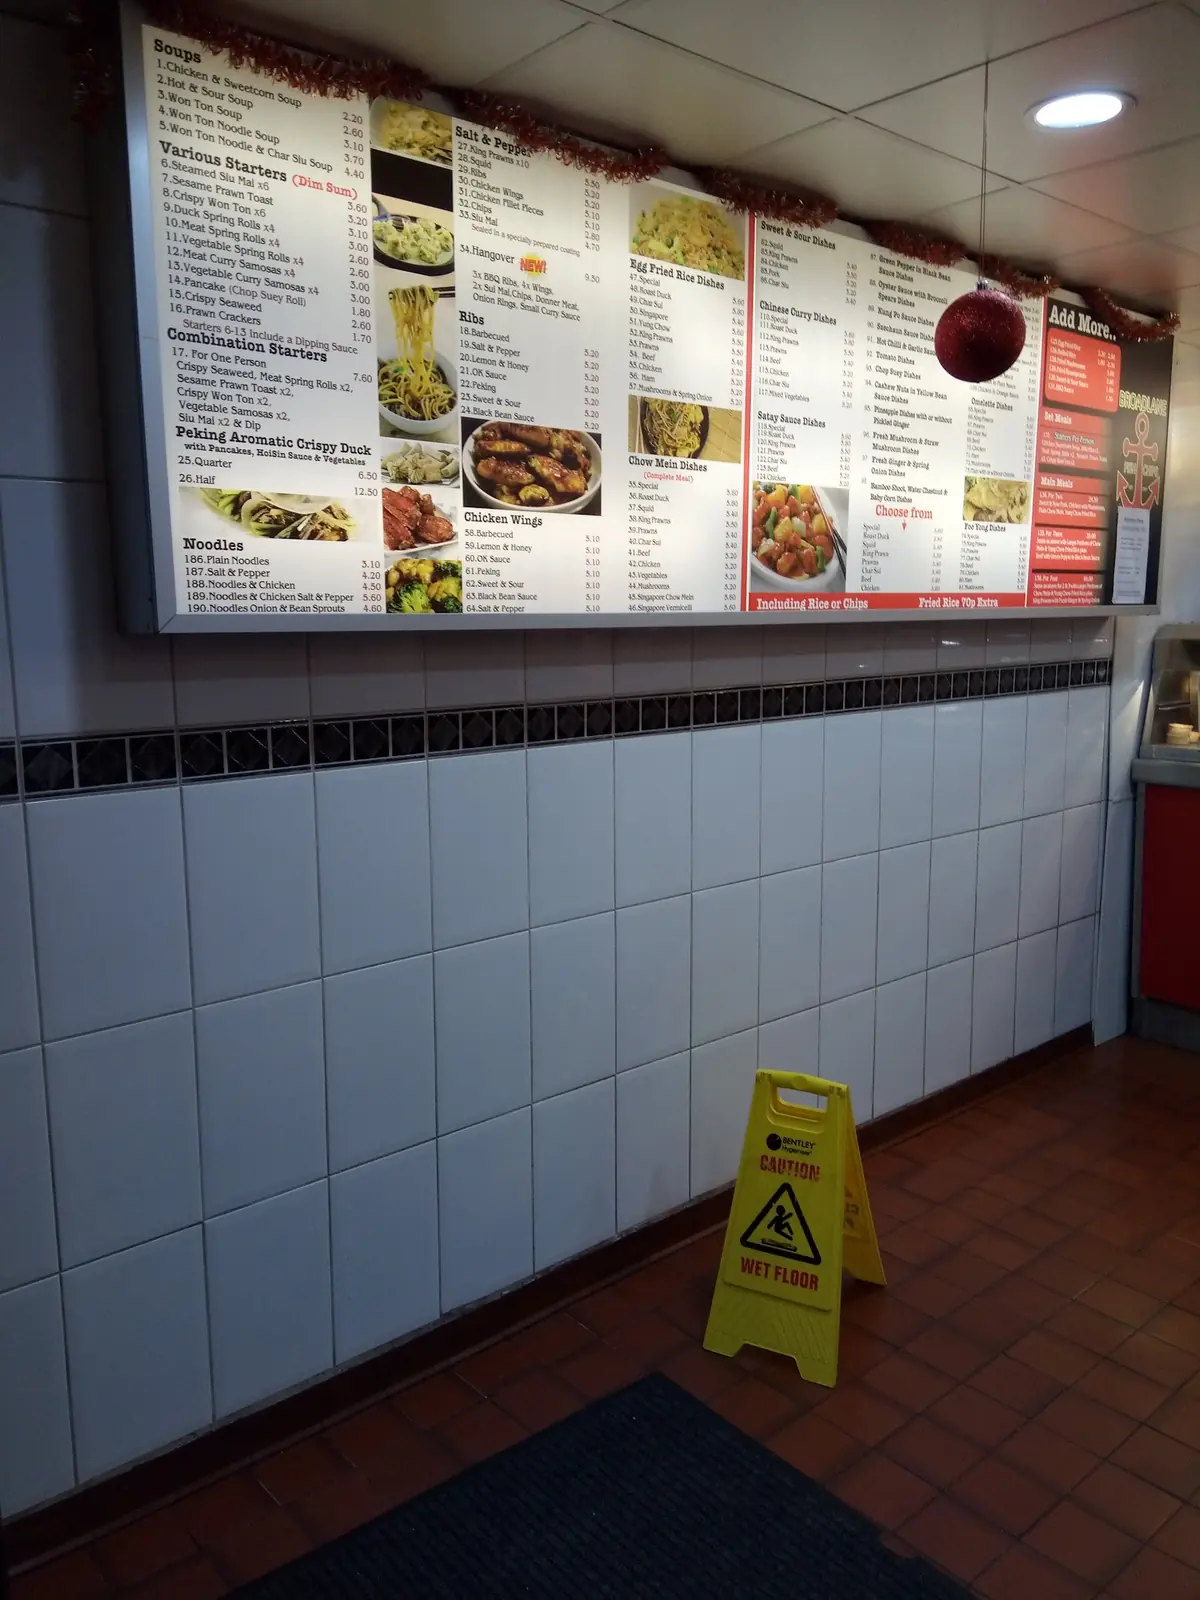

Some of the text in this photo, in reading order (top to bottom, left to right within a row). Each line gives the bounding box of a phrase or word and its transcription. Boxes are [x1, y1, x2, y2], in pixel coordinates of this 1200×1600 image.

[153, 38, 202, 64] Soups
[156, 58, 302, 109] 1.Chicken & Sweetcorn Soup
[157, 88, 243, 122] 3.Won Ton Soup
[342, 111, 364, 125] 2.20
[455, 125, 479, 143] Salt
[481, 133, 492, 146] &
[159, 119, 193, 137] 5.Won
[195, 128, 215, 143] Ton
[217, 134, 253, 152] Noodle
[255, 144, 265, 155] &
[267, 147, 290, 161] Char
[309, 157, 333, 174] Soup
[343, 139, 364, 153] 3.10
[158, 139, 358, 201] Various Starters (Dim Sum)
[344, 166, 365, 180] 4.40
[161, 172, 274, 206] 7.Sesame Prawn Toast
[502, 186, 524, 201] Wings
[163, 201, 275, 233] 9.Duck Spring Rolls x4
[347, 214, 368, 227] 3.20
[760, 219, 836, 250] Sweet & Sour Dishes
[347, 240, 369, 253] 3.00
[167, 245, 296, 278] 12.Meat Curry Samosas x4
[520, 258, 546, 273] NEW!
[629, 257, 725, 290] Egg Fried Rice Dishes
[349, 280, 370, 292] 3.00
[168, 288, 262, 313] 15.Crispy Seaweed
[169, 302, 261, 326] 16.Prawn Crackers
[458, 310, 485, 326] Ribs
[759, 299, 837, 326] Chinese Curry Dishes
[1048, 304, 1076, 330] Add
[351, 319, 372, 331] 2.60
[166, 327, 327, 363] Combination Starters
[352, 332, 372, 344] 1.70
[172, 346, 267, 369] 17. For One Person
[486, 344, 495, 353] &
[495, 345, 521, 358] Pepper
[875, 350, 915, 366] Tomato Dishes
[498, 358, 506, 368] &
[506, 360, 529, 373] Honey
[352, 372, 373, 384] 7.60
[995, 401, 1013, 412] Dishes
[757, 410, 826, 428] Satay Sauce Dishes
[1054, 412, 1072, 425] Meals
[175, 425, 372, 456] Peking Aromatic Crispy Duck
[183, 441, 366, 466] with Pancakes, HoiSin Sauce & Vegetables
[177, 454, 233, 469] 25.Quarter
[628, 455, 707, 472] Chow Mein Dishes
[177, 473, 216, 485] 26.Half
[357, 470, 378, 481] 6.50
[1040, 475, 1073, 489] Main Meals
[354, 486, 379, 497] 12.50
[464, 511, 543, 528] Chicken Wings
[875, 504, 933, 520] Choose from
[988, 523, 1006, 532] Dishes
[182, 537, 244, 552] Noodles
[184, 554, 270, 566] 186.Plain Noodles
[361, 559, 381, 569] 3.10
[489, 555, 511, 564] Sauce
[184, 566, 271, 579] 187.Salt & Pepper
[361, 571, 381, 580] 4.20
[492, 604, 500, 613] &
[501, 604, 525, 614] Pepper
[756, 597, 869, 610] Including Rice or Chips
[918, 596, 941, 609] Fried
[942, 596, 960, 609] Rice
[976, 596, 999, 608] Extra
[783, 1136, 813, 1149] BENTLEY
[761, 1155, 820, 1182] CAUTION
[741, 1256, 819, 1291] WET FLOOR
